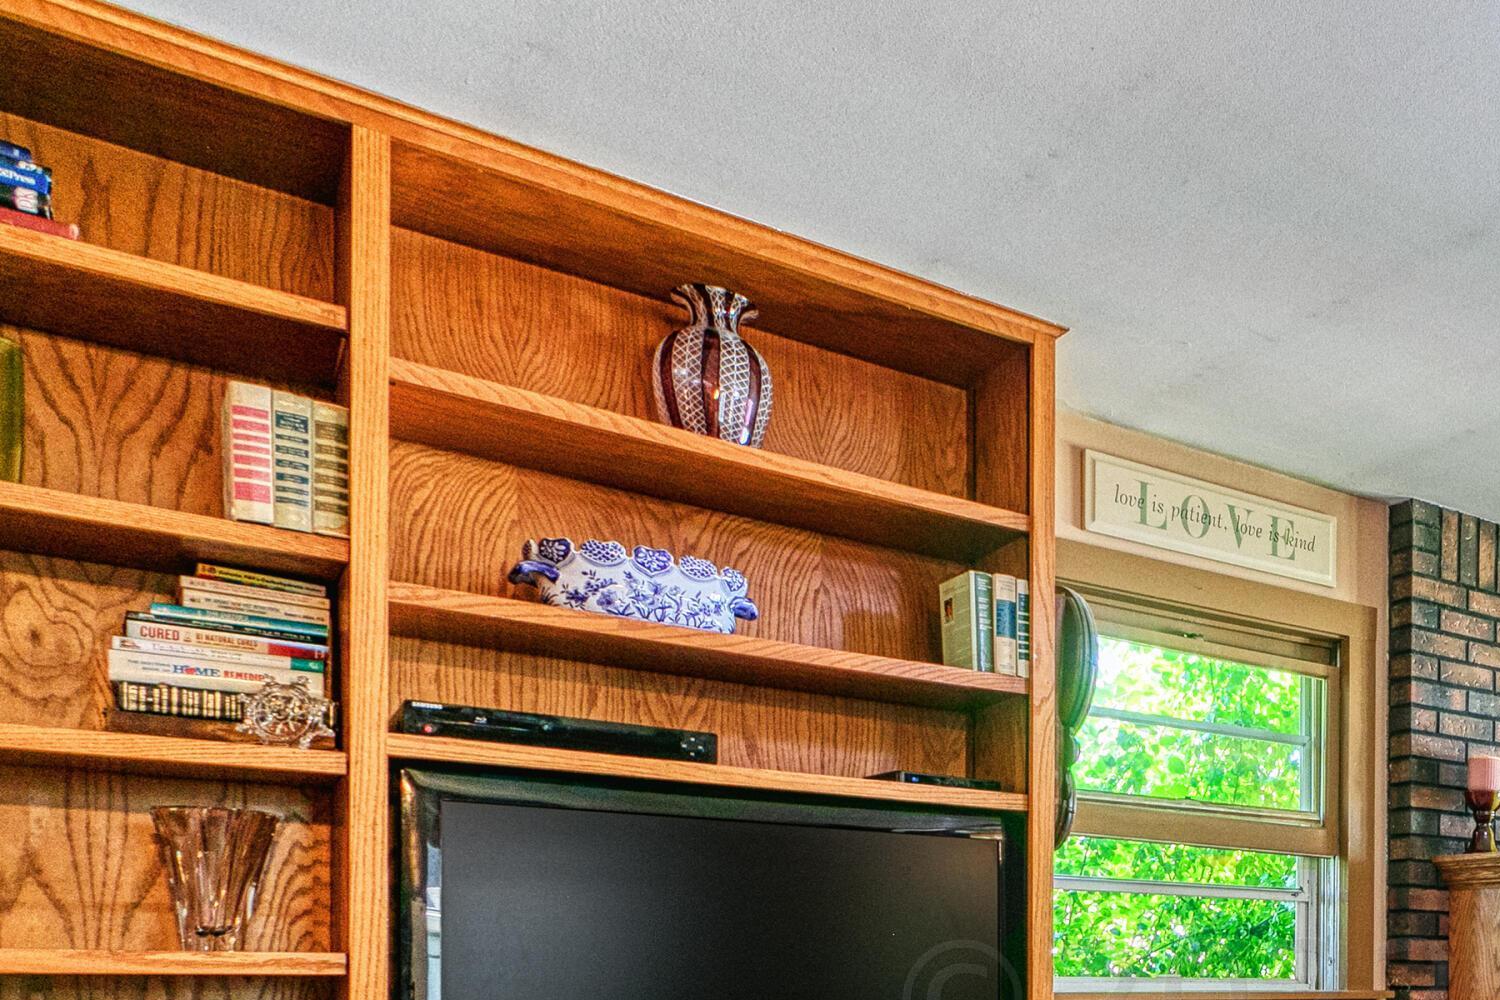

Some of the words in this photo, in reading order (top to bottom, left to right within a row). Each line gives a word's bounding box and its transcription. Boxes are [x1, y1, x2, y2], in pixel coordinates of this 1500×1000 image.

[1114, 484, 1145, 509] love
[1152, 494, 1165, 514] is
[1170, 504, 1228, 531] patient,
[1236, 515, 1262, 539] love
[1269, 524, 1280, 543] is
[1285, 528, 1316, 553] kind
[140, 625, 180, 641] CURED
